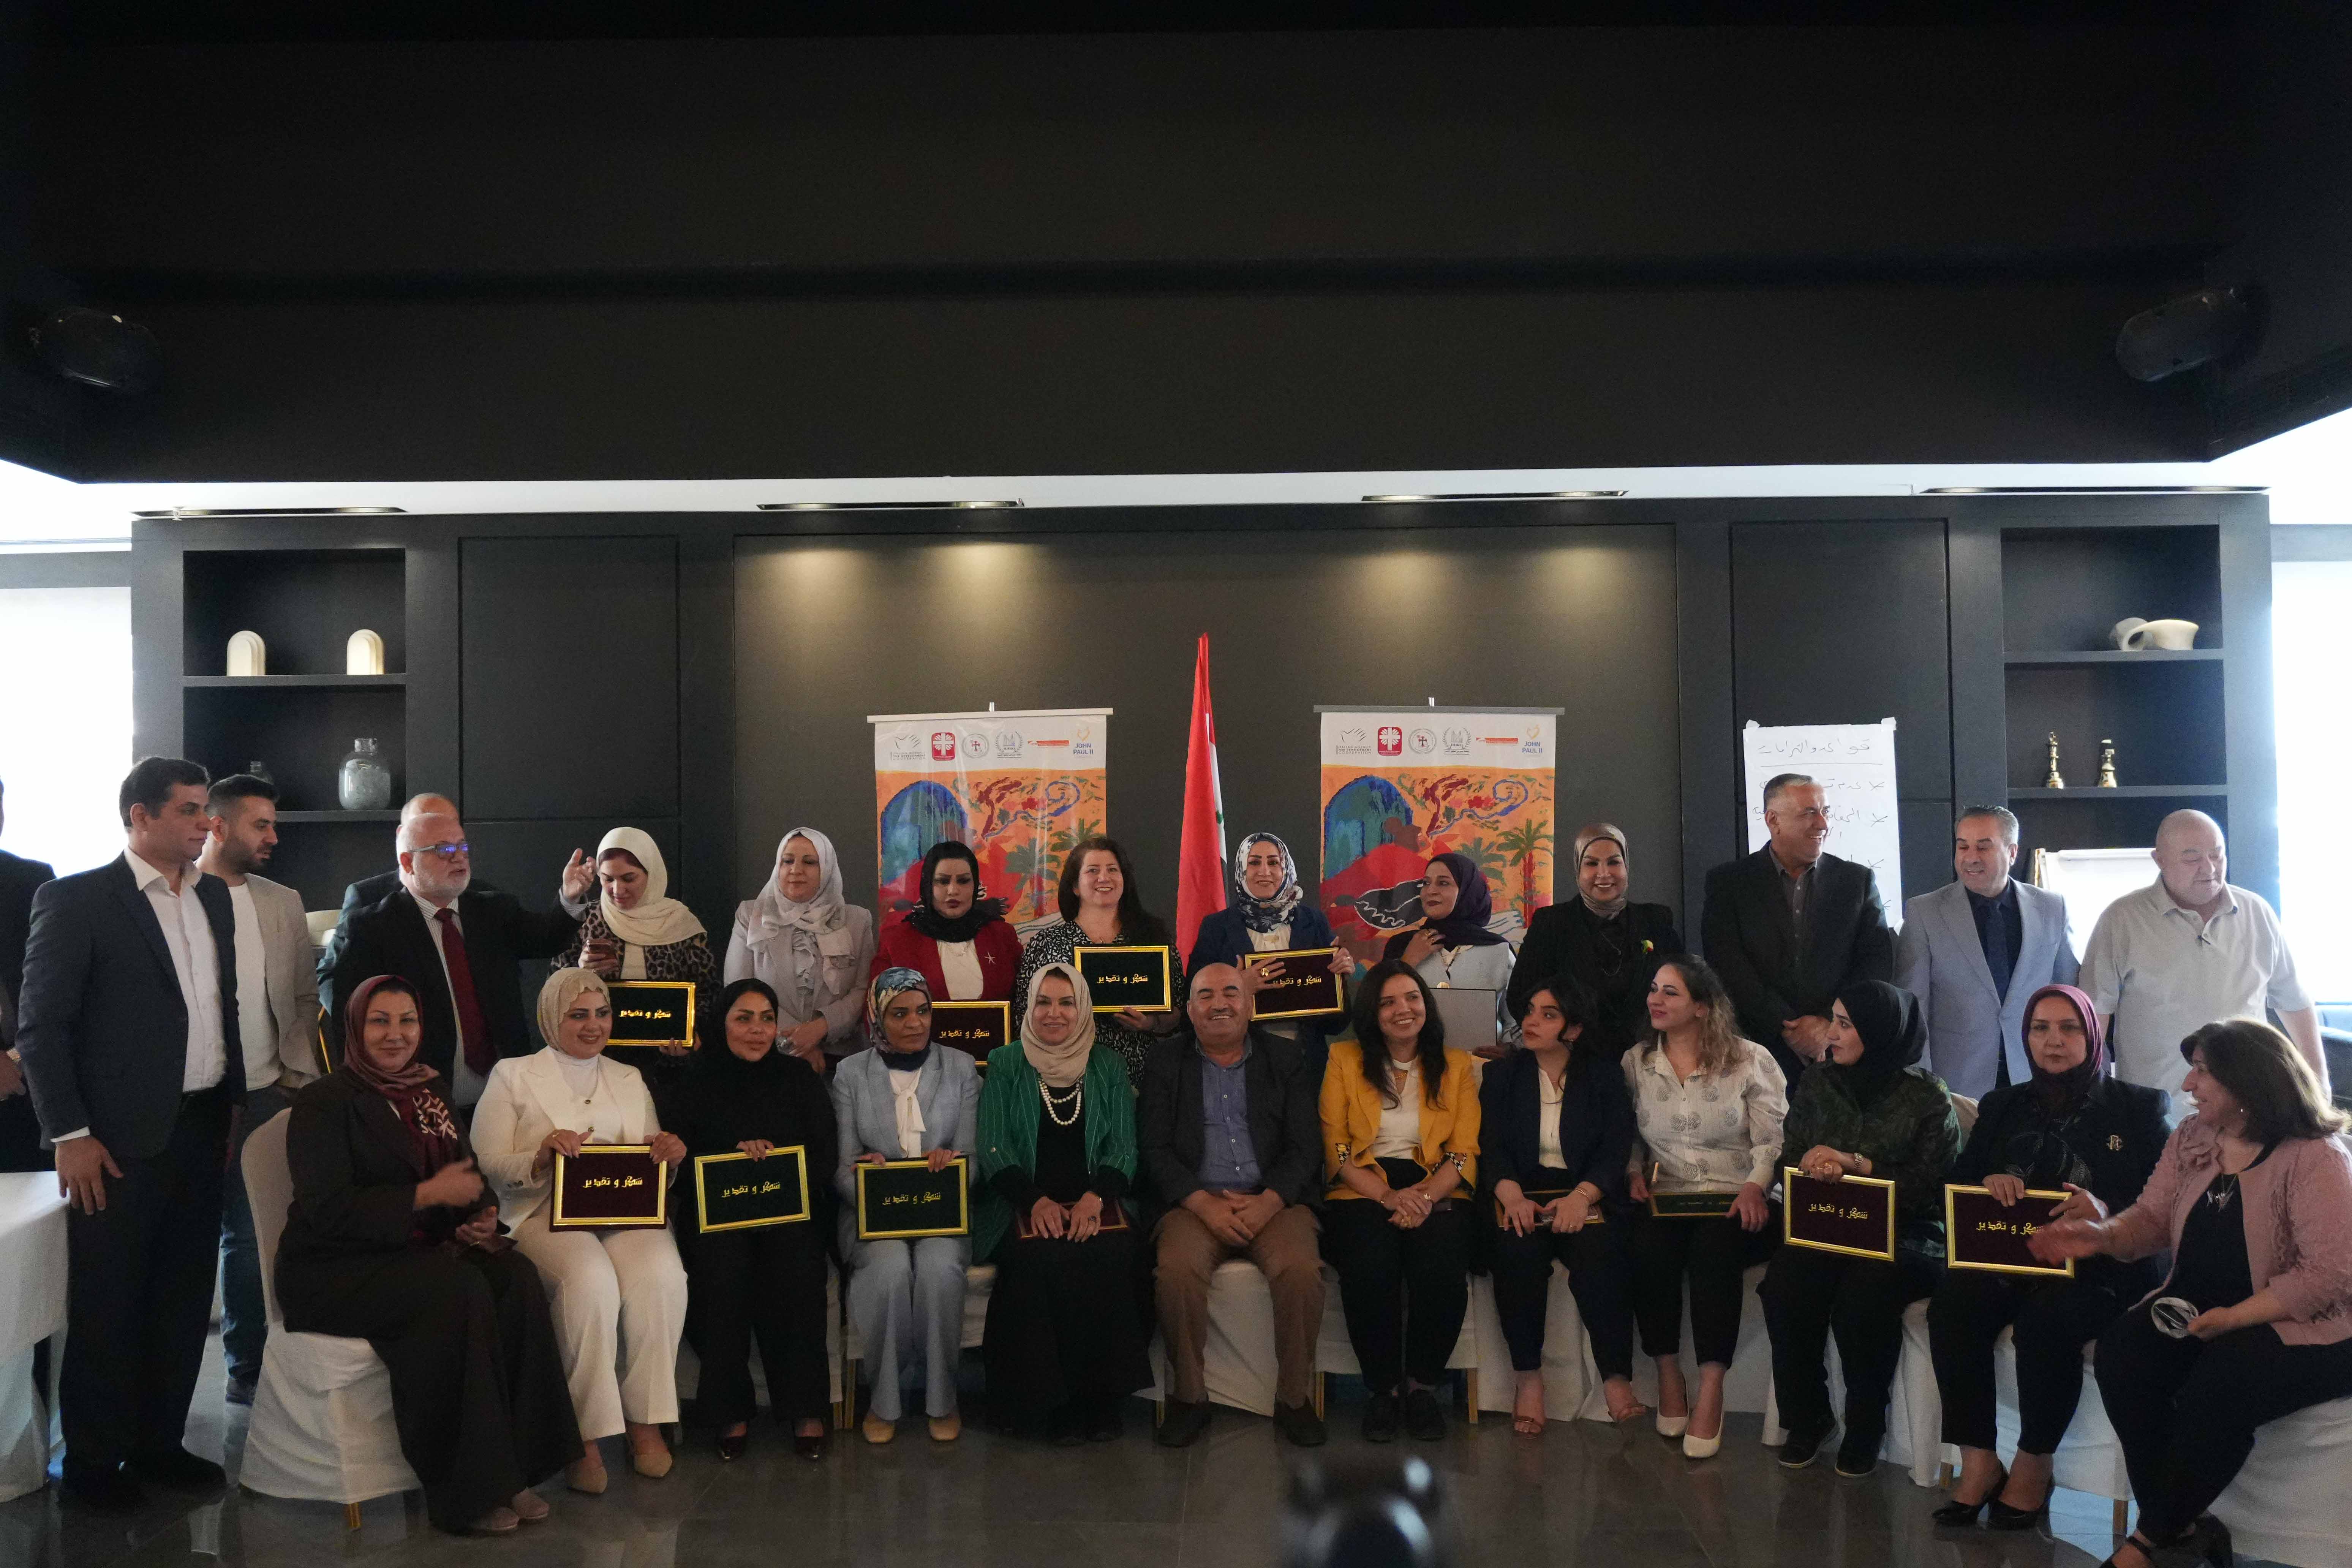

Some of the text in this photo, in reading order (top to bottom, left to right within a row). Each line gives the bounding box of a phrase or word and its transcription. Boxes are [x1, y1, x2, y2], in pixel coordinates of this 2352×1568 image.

[1096, 974, 1120, 983] تقدير
[1130, 973, 1148, 984] شكر
[1304, 975, 1321, 986] شكر
[939, 1029, 962, 1038] تقدير
[972, 1029, 989, 1039] شكر
[582, 1176, 643, 1188] شكر و تقدير
[721, 1181, 781, 1198] شكر و تقدير
[882, 1192, 940, 1205] شكر و تقدير
[1808, 1203, 1868, 1219] شكر و تقدير
[1976, 1221, 2006, 1231] تقدير
[2011, 1225, 2016, 1234] و
